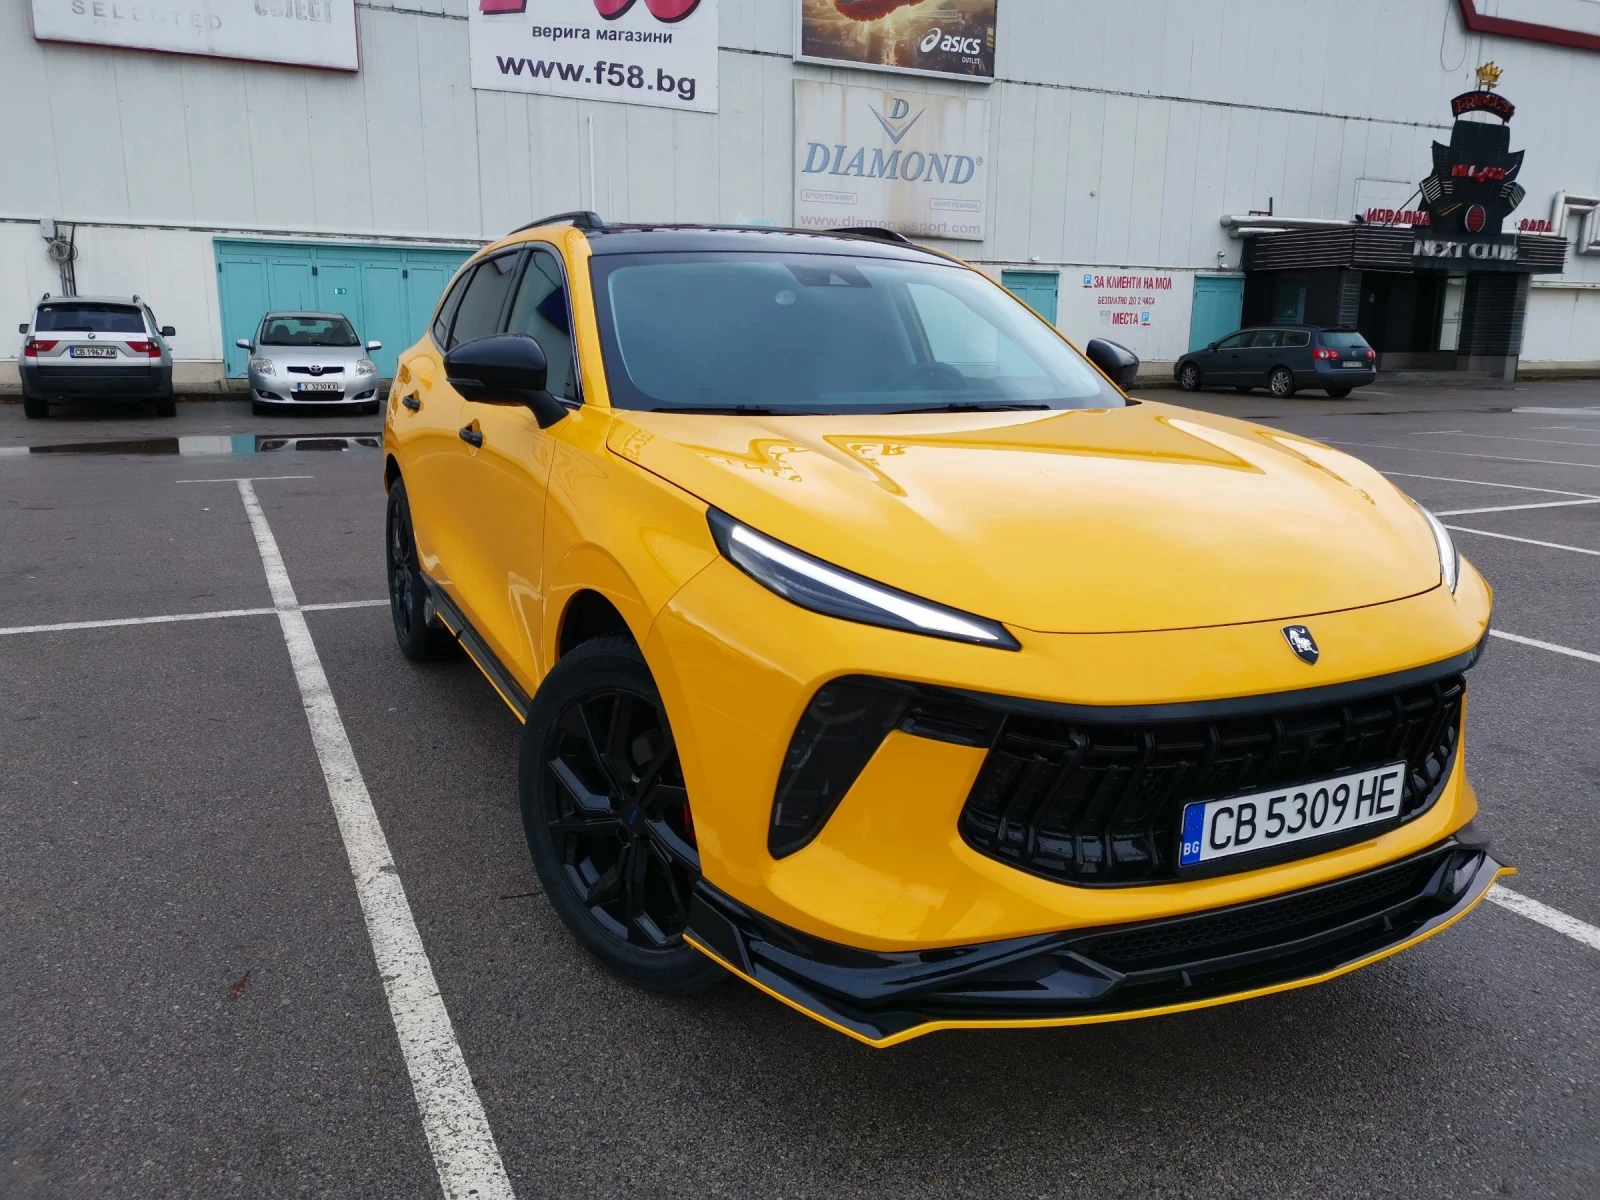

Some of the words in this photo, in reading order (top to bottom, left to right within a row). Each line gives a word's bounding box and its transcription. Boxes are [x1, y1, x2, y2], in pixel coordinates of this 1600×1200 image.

[71, 0, 223, 30] SELECTED
[531, 26, 591, 42] верига
[596, 29, 673, 44] магазини
[940, 34, 982, 55] asics
[961, 56, 981, 65] OUTLET
[496, 56, 696, 101] www.f58.bg
[888, 97, 910, 120] D
[1365, 208, 1431, 226] ИГРАЛНА
[1520, 219, 1553, 232] ЗАЛА
[1413, 239, 1468, 259] NEXT
[1468, 242, 1519, 260] CLUB
[1094, 276, 1105, 288] ЗА
[1106, 276, 1142, 289] КЛИЕНТИ
[1143, 277, 1154, 290] НА
[1155, 277, 1172, 290] МОЛ
[1098, 296, 1128, 305] БЕЗПЛАТНО
[1128, 297, 1136, 307] ДО
[1112, 312, 1139, 325] МЕСТА
[75, 348, 86, 356] CB
[1209, 802, 1257, 850] CB
[1264, 783, 1350, 839] 5309
[1354, 771, 1399, 820] HE
[1183, 841, 1200, 856] BG
